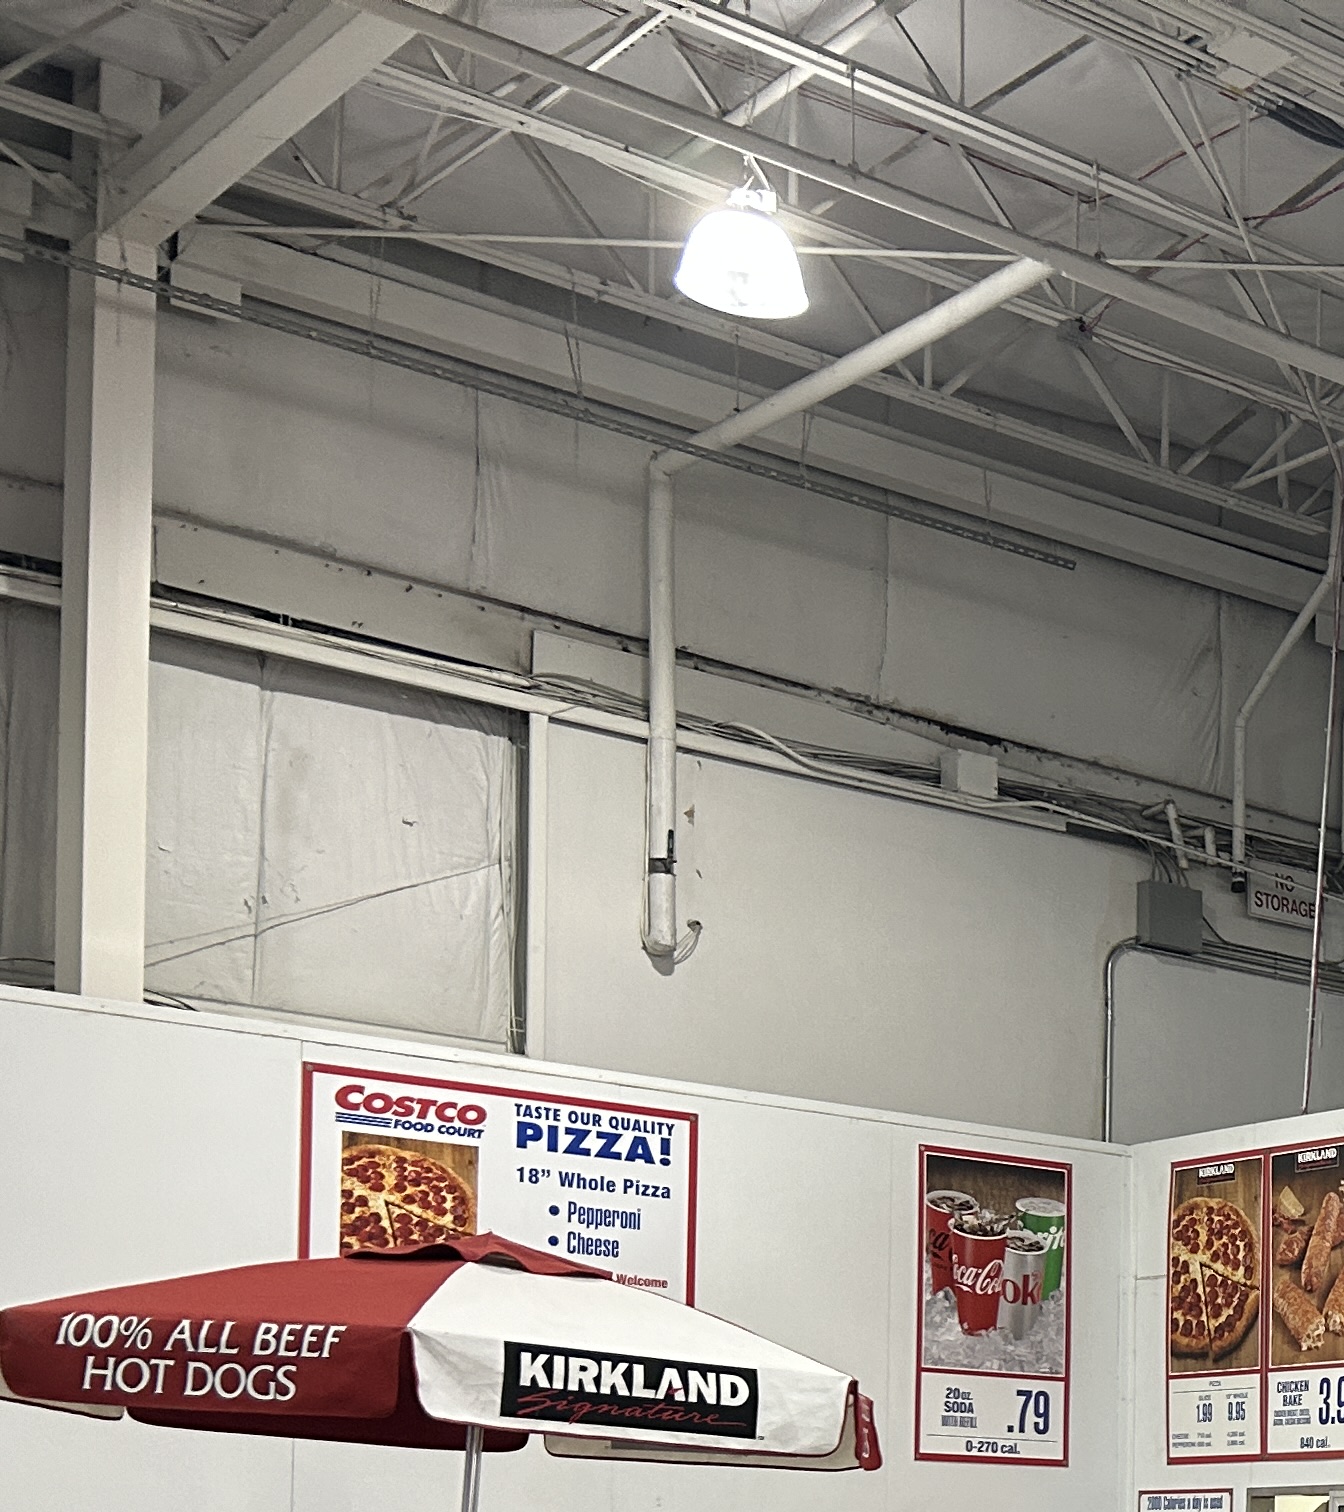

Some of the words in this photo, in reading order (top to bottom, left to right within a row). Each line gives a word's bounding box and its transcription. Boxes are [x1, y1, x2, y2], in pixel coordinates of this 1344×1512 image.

[1275, 873, 1295, 892] NO
[1254, 891, 1316, 919] STORAGE
[335, 1085, 487, 1125] COSTCO
[393, 1119, 434, 1135] FOOD
[437, 1123, 484, 1139] COURT
[514, 1103, 561, 1122] TASTE
[568, 1109, 601, 1127] OUR
[609, 1115, 675, 1137] QUALITY
[515, 1121, 672, 1167] PIZZA!
[1297, 1148, 1337, 1164] KIRKLAND
[559, 1172, 616, 1193] Whole
[623, 1179, 671, 1200] Pizza
[567, 1201, 641, 1231] Pepperoni
[567, 1231, 620, 1258] Cheese
[615, 1272, 668, 1290] Welcome
[55, 1312, 153, 1350] 100%
[164, 1319, 245, 1354] ALL
[252, 1323, 347, 1358] BEEF
[82, 1356, 174, 1394] HOT
[183, 1361, 297, 1401] DOGS
[519, 1352, 750, 1407] KIRKLAND
[1277, 1380, 1309, 1393] CHICKEN
[516, 1389, 747, 1427] Signature
[944, 1401, 974, 1414] SODA
[1007, 1389, 1051, 1435] .79
[1196, 1403, 1212, 1422] 1.99
[1227, 1401, 1246, 1421] 9.95
[1282, 1395, 1303, 1406] BAKE
[966, 1440, 998, 1453] 0-270
[1001, 1442, 1021, 1455] cal.
[1315, 1437, 1330, 1448] cal.
